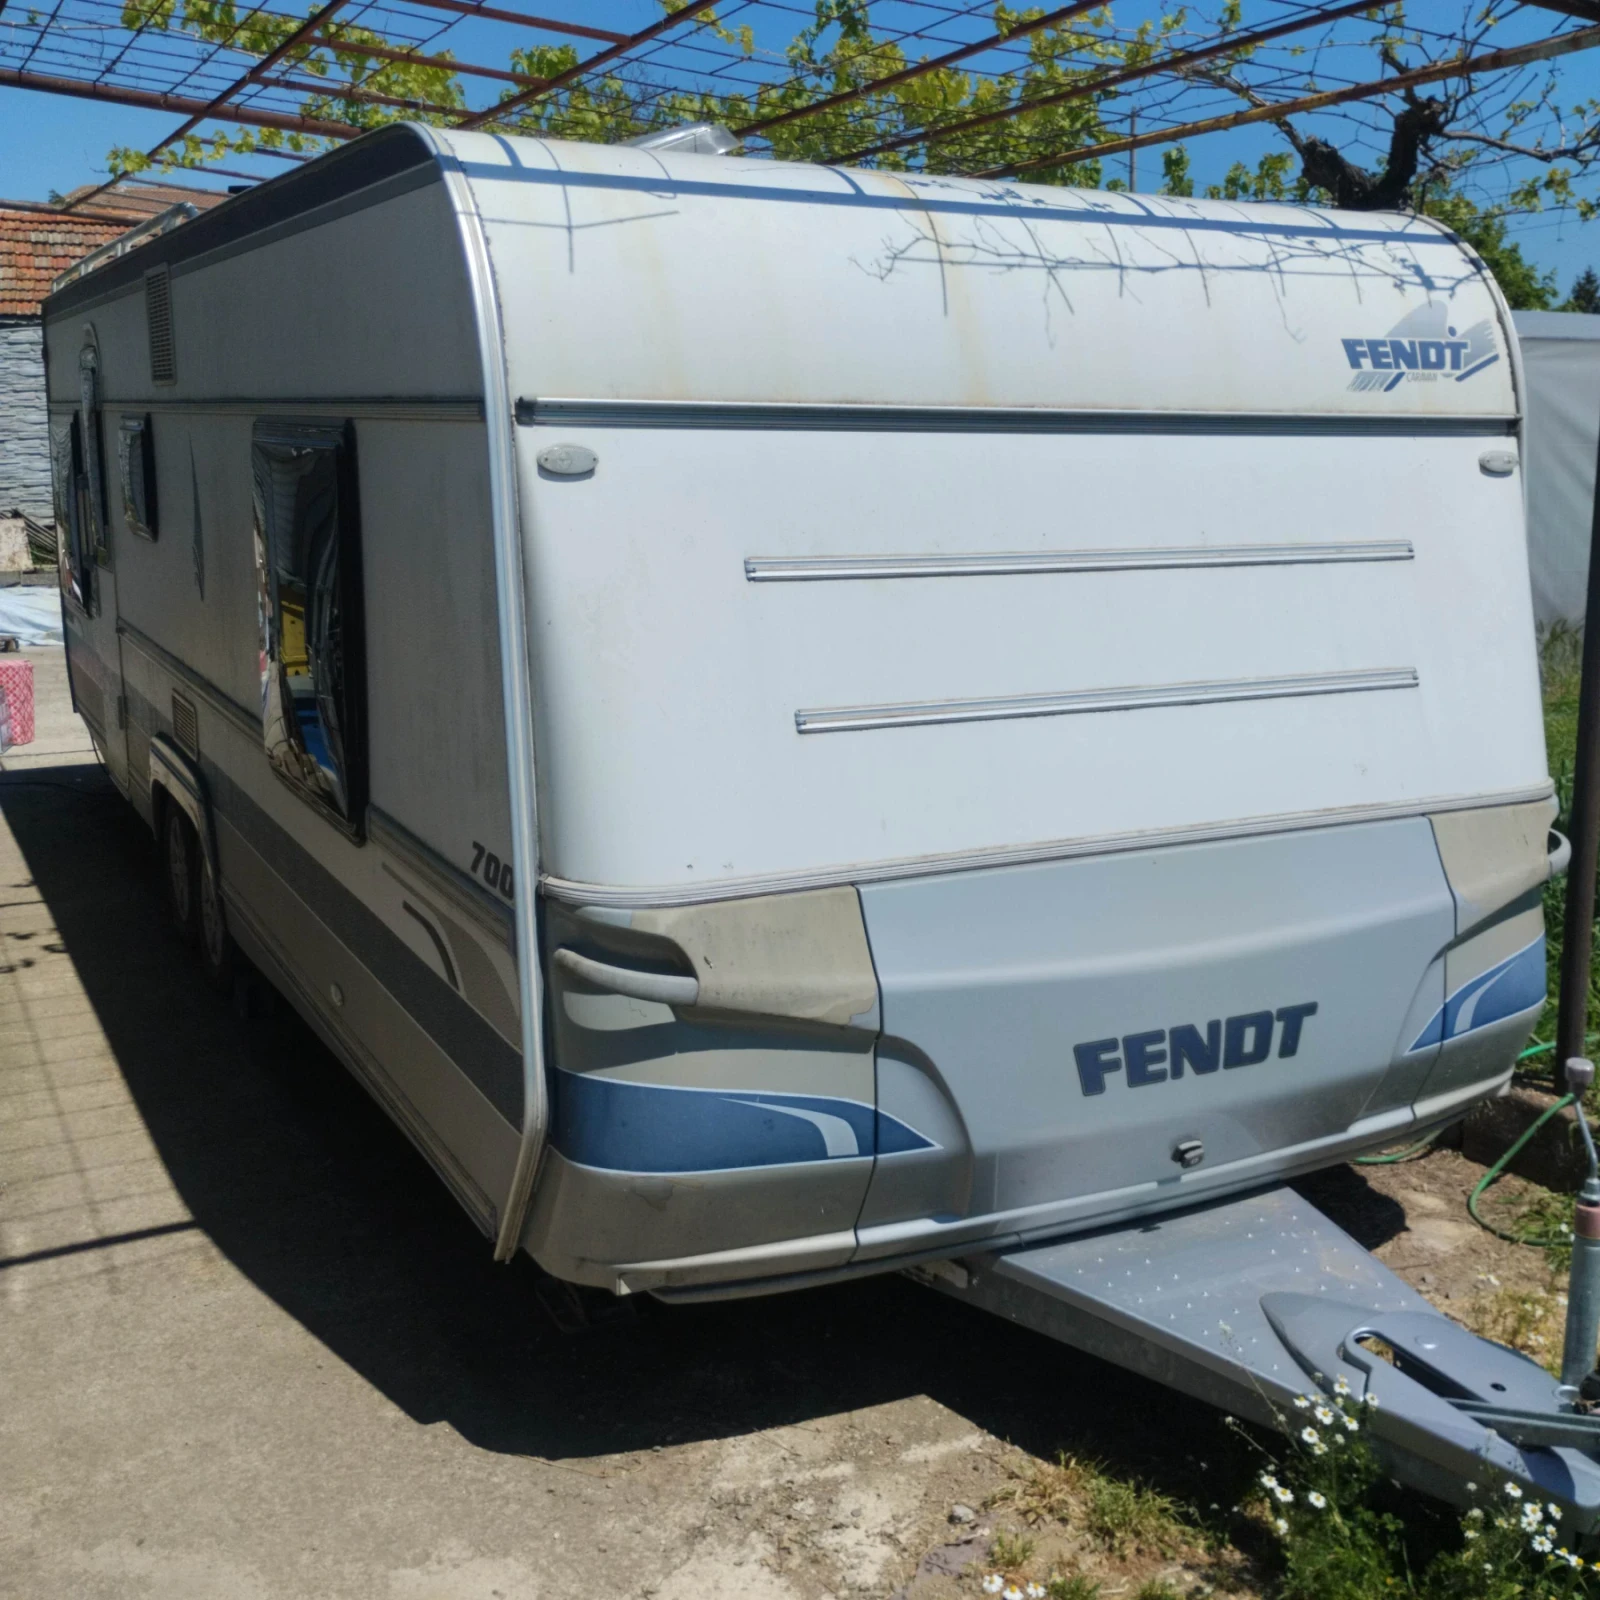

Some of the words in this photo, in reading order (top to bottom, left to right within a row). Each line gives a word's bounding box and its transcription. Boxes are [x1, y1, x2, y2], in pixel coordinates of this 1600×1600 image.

[1341, 338, 1468, 370] FENDT
[471, 841, 514, 900] 700
[1073, 1001, 1318, 1096] FENDT
